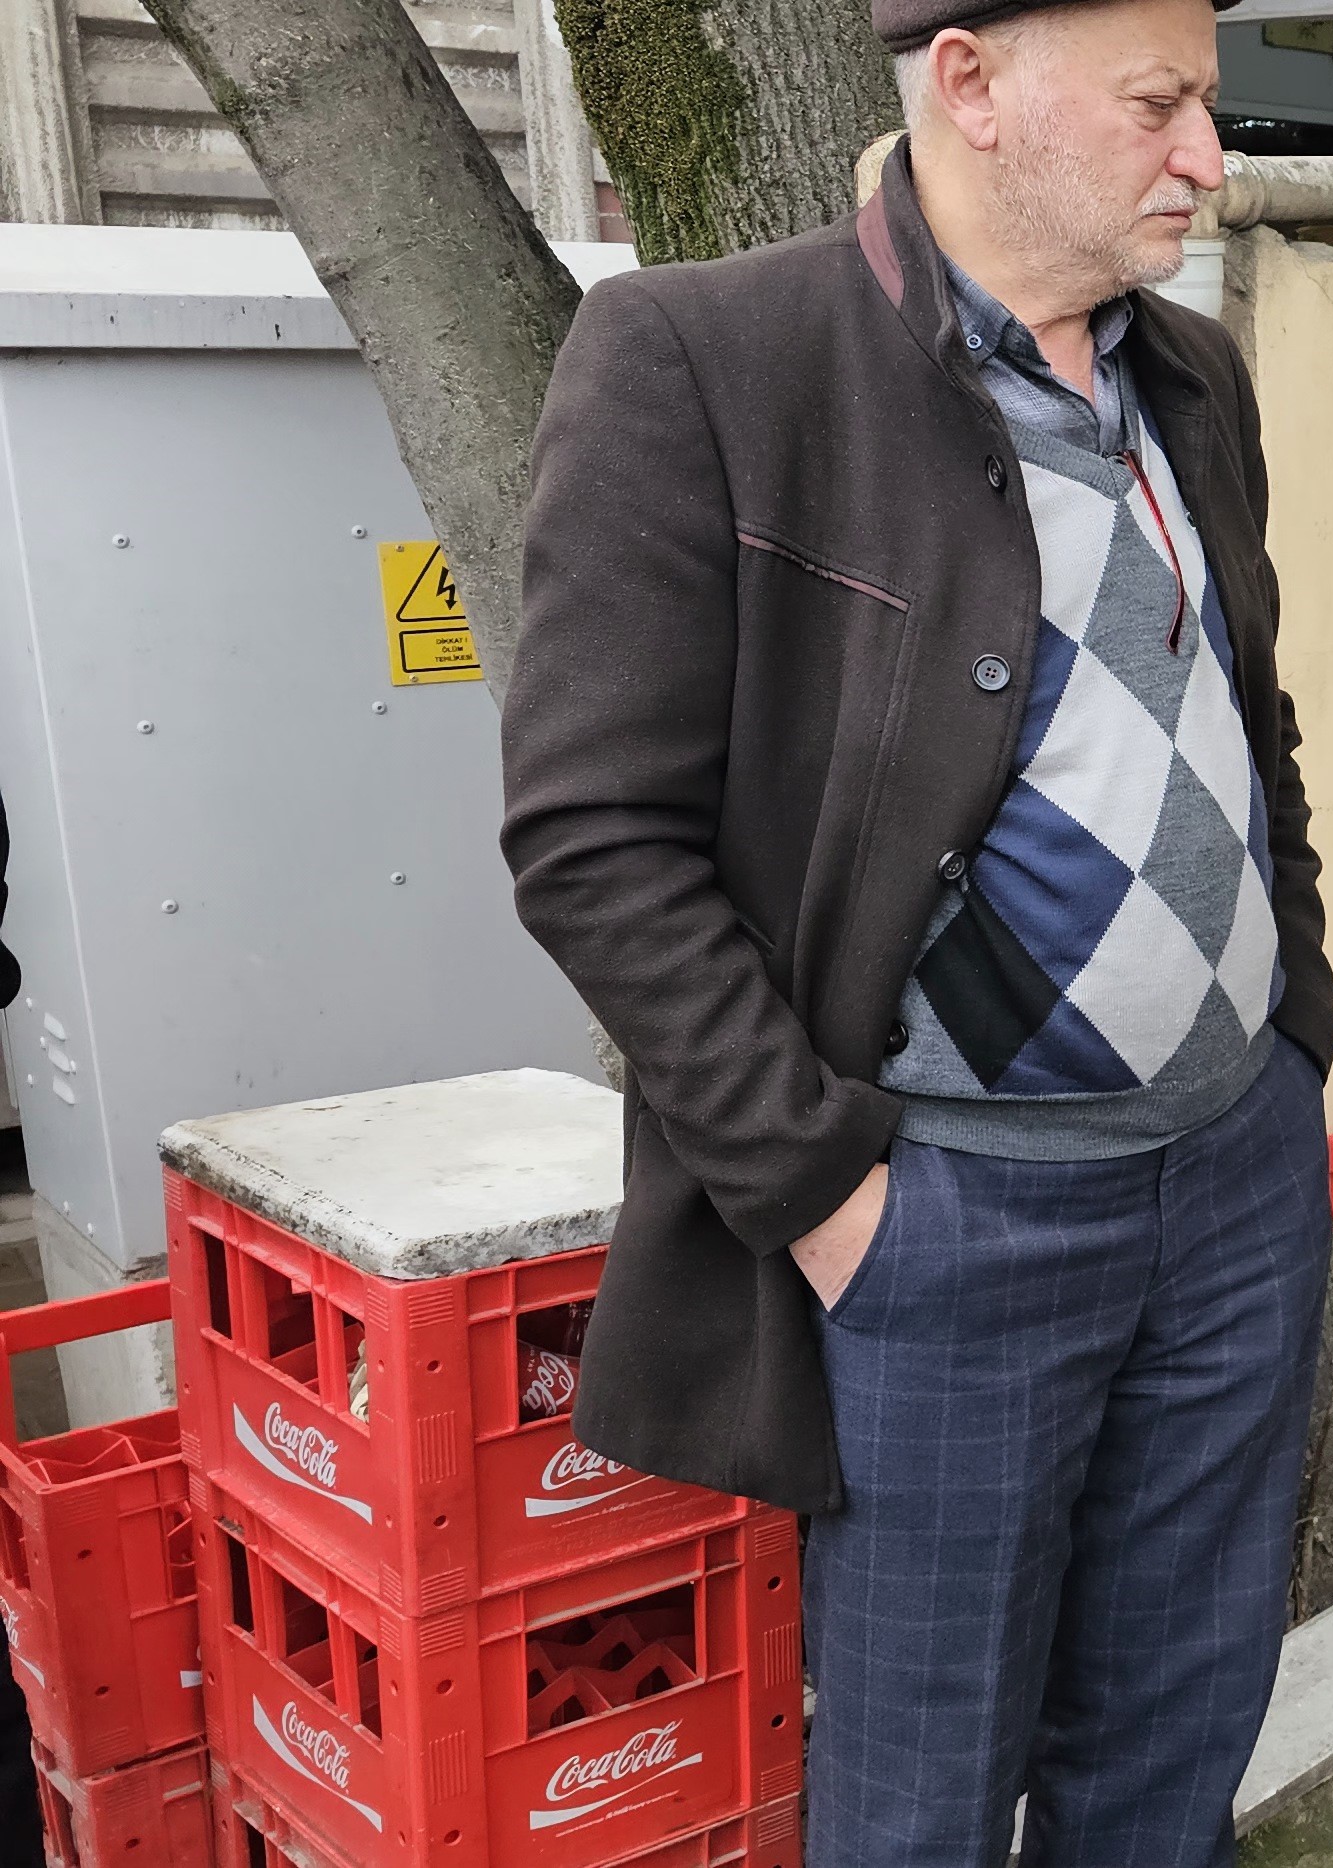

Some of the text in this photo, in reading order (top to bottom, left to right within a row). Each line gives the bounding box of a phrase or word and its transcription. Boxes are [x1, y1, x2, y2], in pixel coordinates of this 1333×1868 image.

[522, 1351, 575, 1417] Cola
[264, 1401, 339, 1488] Coca-Cola
[281, 1700, 351, 1788] Coca-Cola
[545, 1718, 684, 1802] Coca-Cola
